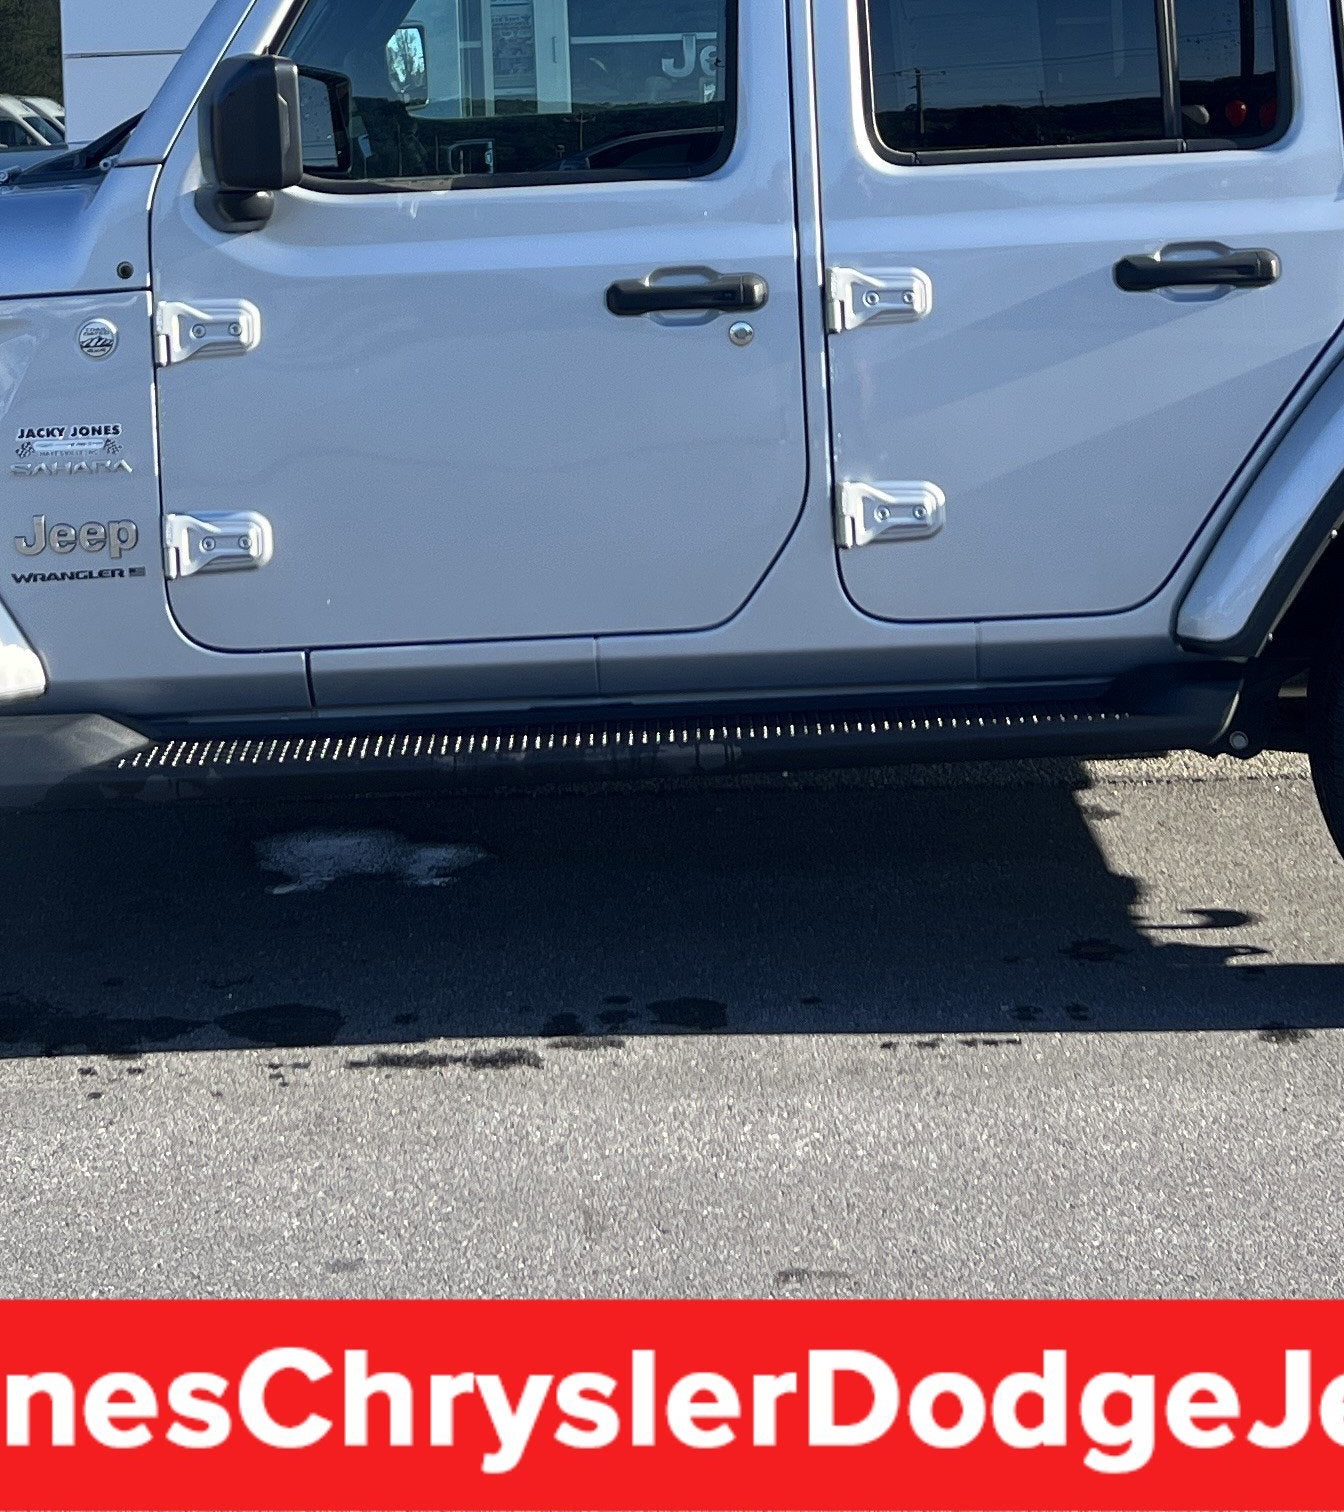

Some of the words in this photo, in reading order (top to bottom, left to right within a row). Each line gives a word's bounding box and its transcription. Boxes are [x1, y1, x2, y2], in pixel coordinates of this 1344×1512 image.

[17, 426, 66, 439] JACKY
[71, 424, 121, 437] JONES
[14, 514, 139, 559] Jeep
[11, 569, 126, 584] WRANGLER
